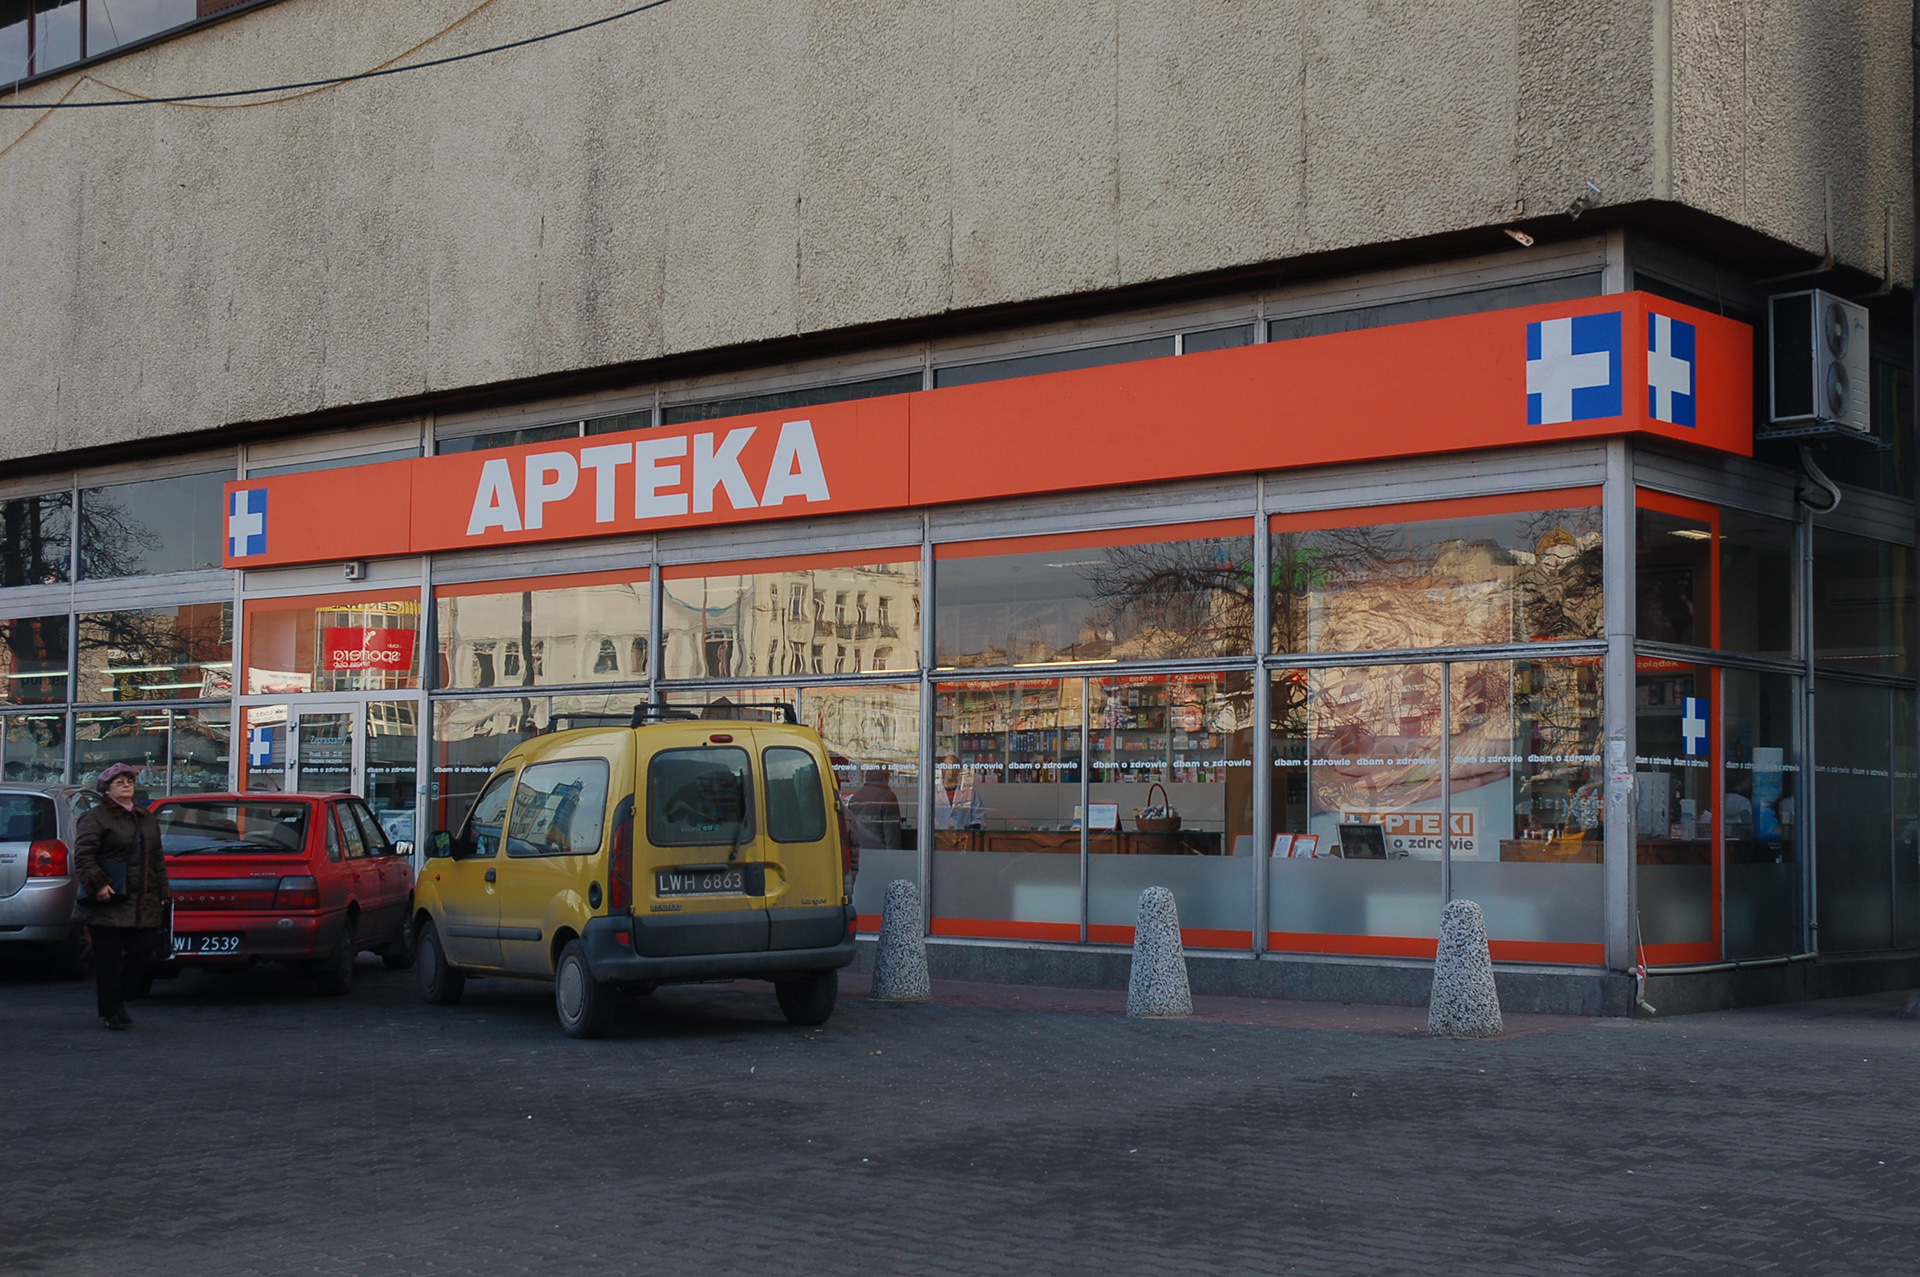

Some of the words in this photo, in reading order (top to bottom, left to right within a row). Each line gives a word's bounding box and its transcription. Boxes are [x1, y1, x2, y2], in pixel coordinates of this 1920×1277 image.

[466, 420, 830, 536] APTEKA
[1092, 760, 1119, 769] dbam
[1129, 760, 1168, 768] zdrowie
[1172, 758, 1200, 768] dbam
[1211, 758, 1252, 767] zdrowie
[1274, 758, 1301, 767] dbam
[1312, 758, 1351, 766] zdrowie
[1356, 757, 1384, 766] dbam
[1396, 756, 1437, 765] zdrowie
[1453, 755, 1477, 763] dbam
[1487, 754, 1523, 763] zdrowie
[1527, 754, 1553, 762] dbam
[1563, 753, 1601, 762] zdrowie
[937, 762, 960, 770] dbam
[970, 762, 1004, 770] zdrowie
[1008, 761, 1033, 769] dbam
[1042, 761, 1078, 769] zdrowie
[1393, 839, 1404, 848] o
[659, 874, 696, 891] LWH
[702, 872, 743, 889] 6863
[201, 936, 240, 951] 2539
